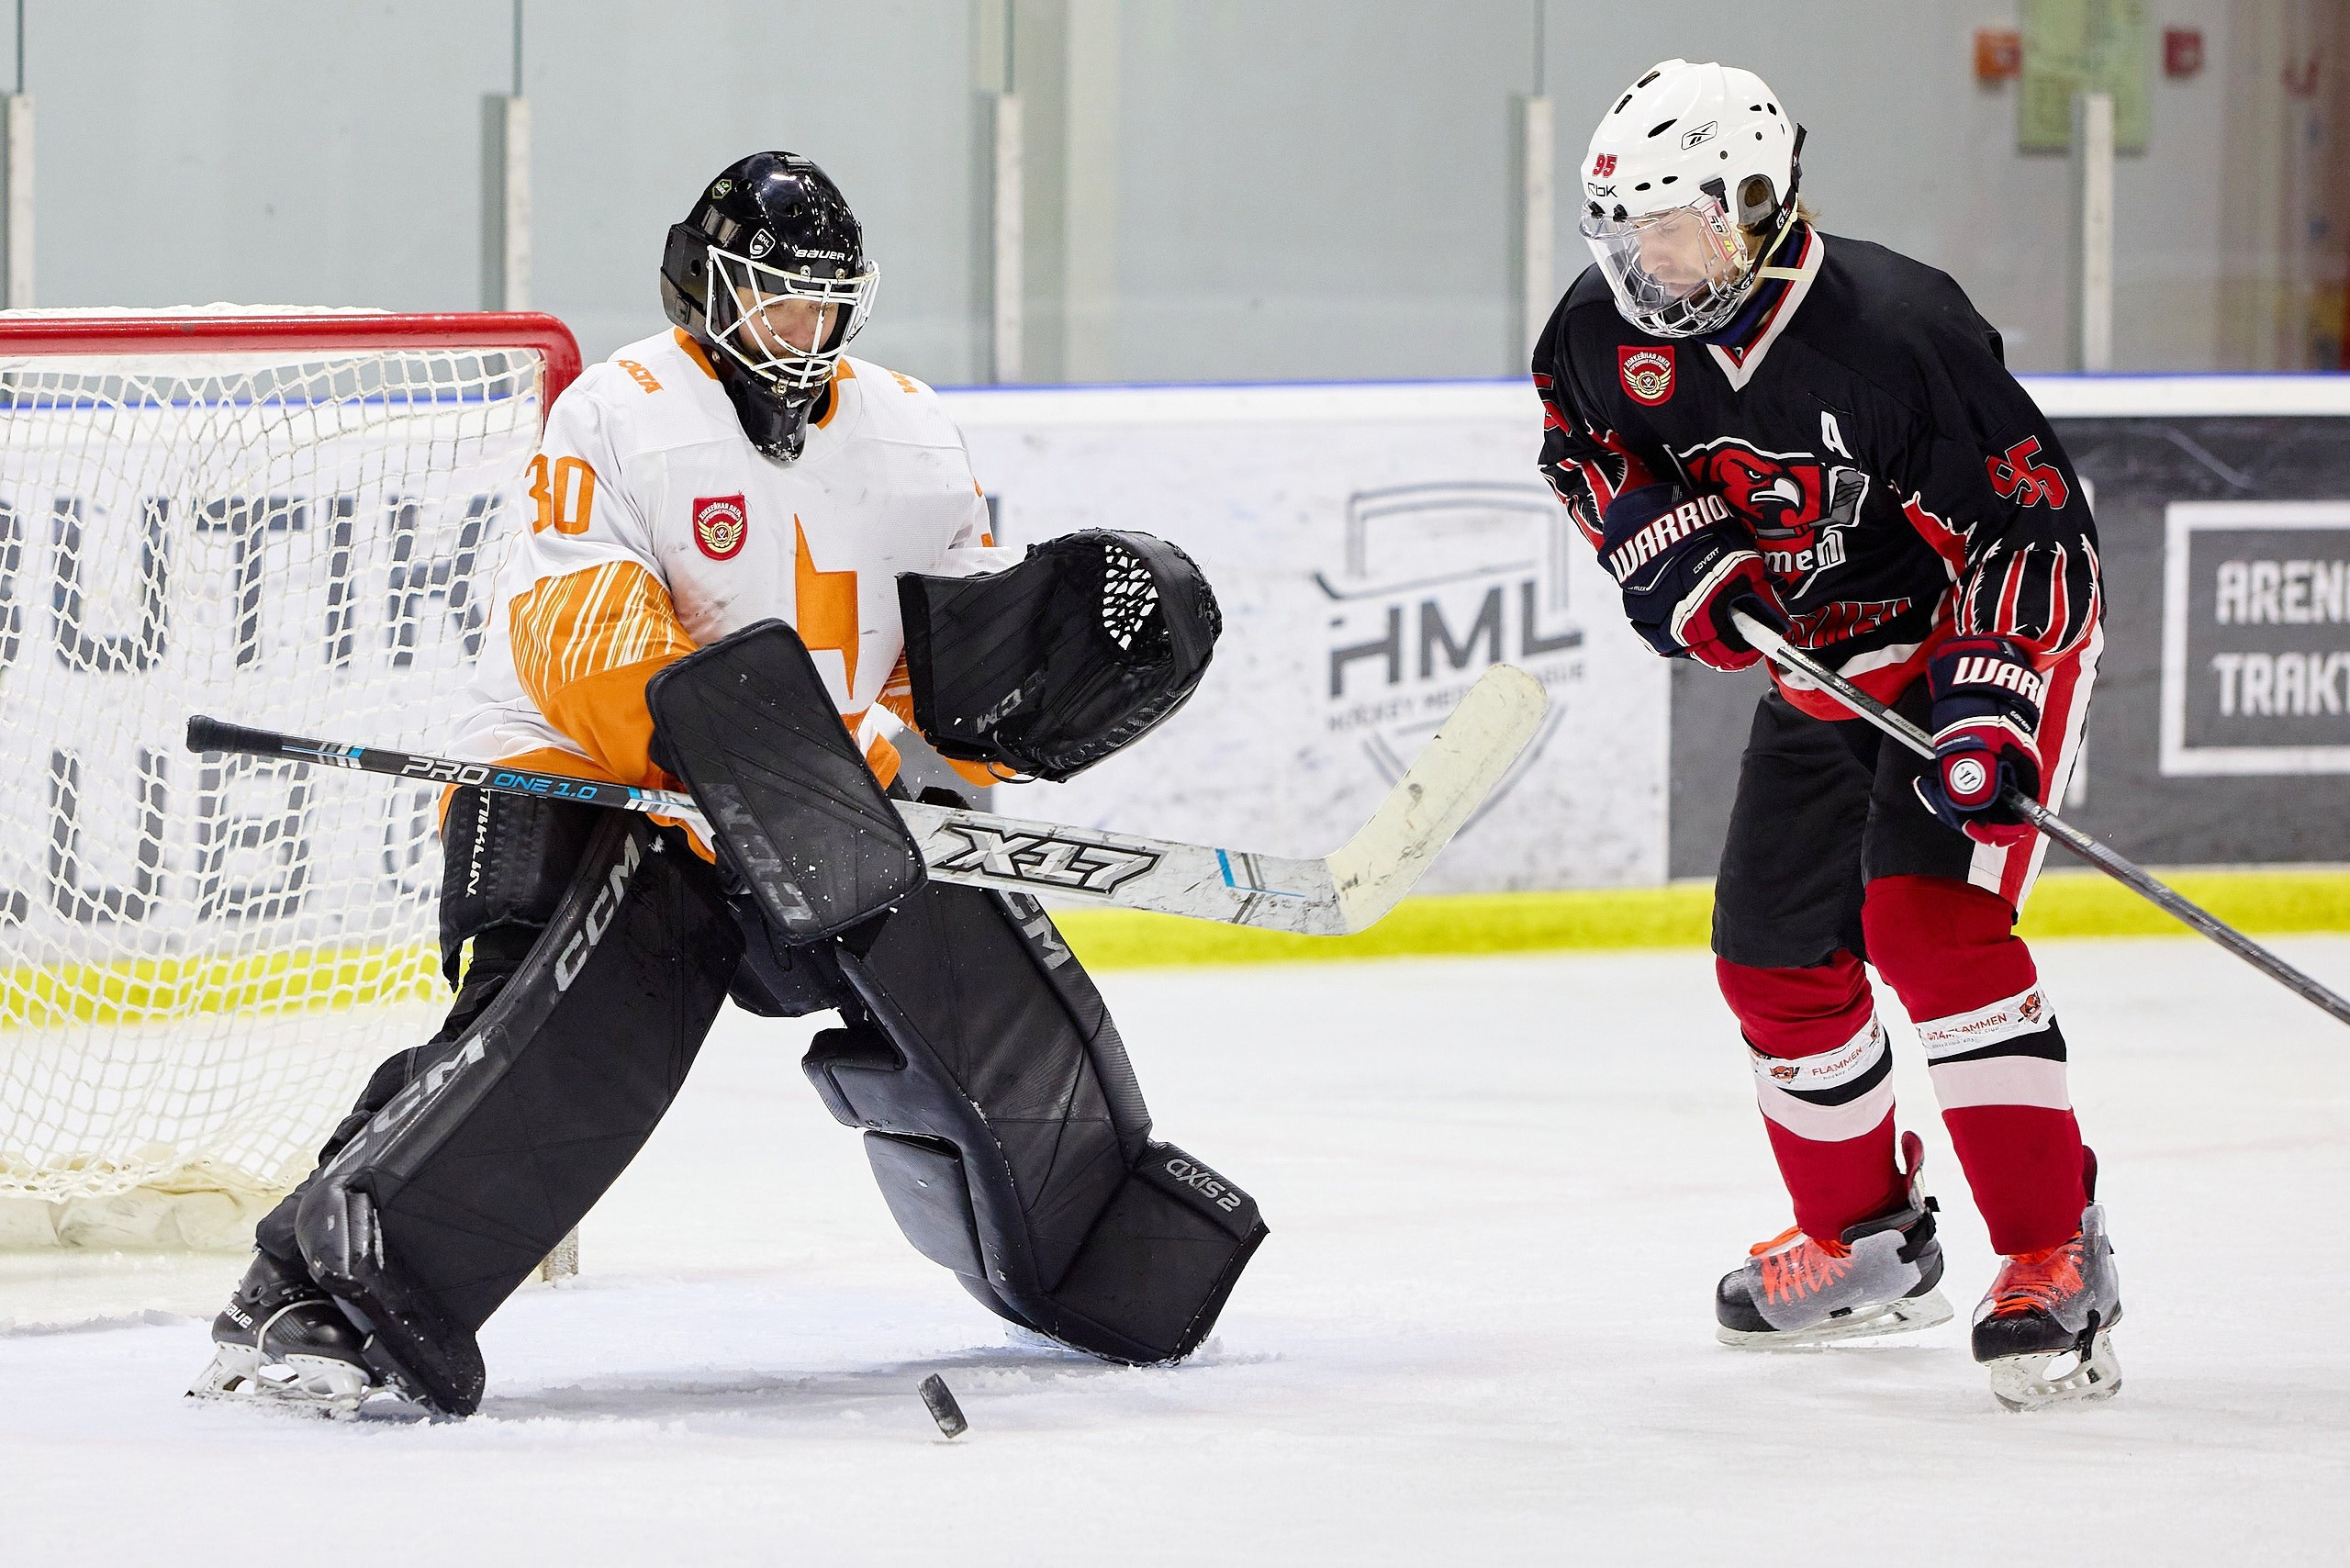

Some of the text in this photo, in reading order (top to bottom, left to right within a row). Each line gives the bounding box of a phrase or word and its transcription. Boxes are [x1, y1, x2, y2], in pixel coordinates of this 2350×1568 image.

[1592, 152, 1618, 178] 95
[756, 232, 772, 249] SHL
[617, 359, 665, 395] OLTA
[1820, 410, 1854, 460] A
[524, 453, 596, 535] 30
[1985, 434, 2070, 510] 95
[1607, 494, 1735, 585] WARRIO
[1693, 546, 1720, 575] COVERT
[2214, 559, 2350, 625] AREN
[1330, 577, 1584, 697] HML
[400, 756, 599, 801] PRO ONE 1.0
[554, 832, 641, 992] CCM
[998, 889, 1072, 971] CM
[1811, 1046, 1863, 1076] FLAMMEN
[322, 1030, 486, 1180] CCM
[1215, 1192, 1242, 1213] 2
